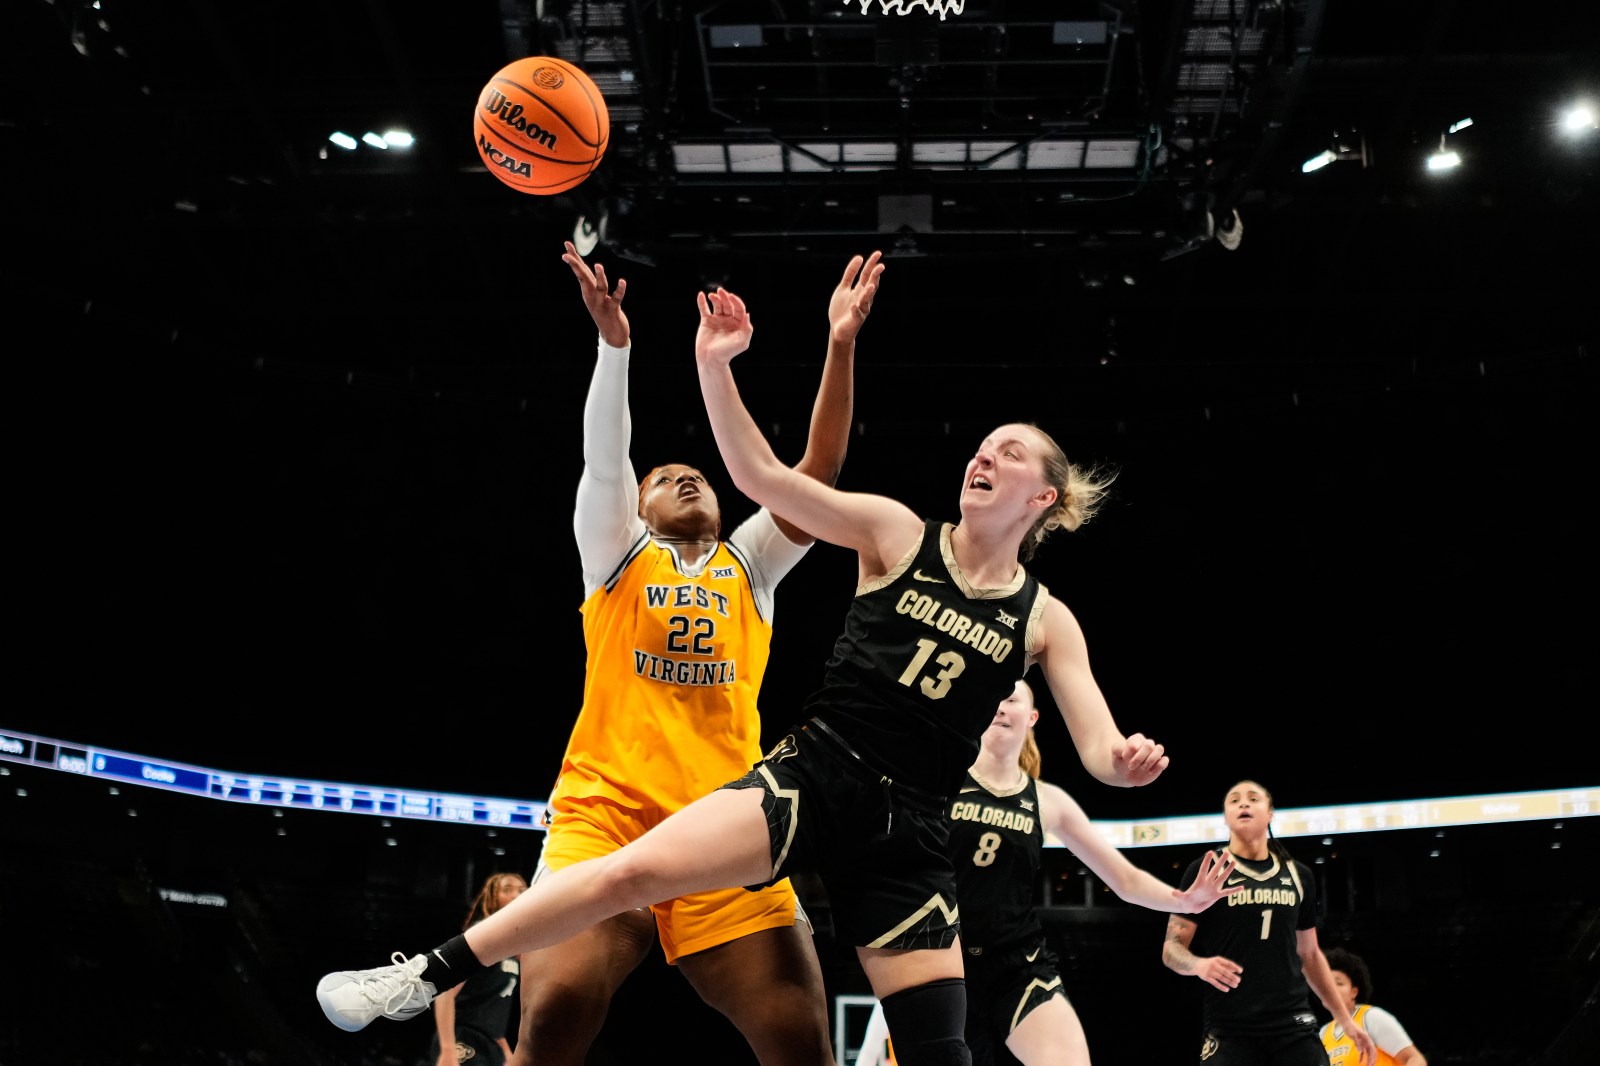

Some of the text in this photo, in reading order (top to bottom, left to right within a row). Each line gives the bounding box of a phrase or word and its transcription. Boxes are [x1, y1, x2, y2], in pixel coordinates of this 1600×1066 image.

[483, 88, 558, 151] Wilson
[477, 133, 533, 178] NCAA
[645, 584, 730, 618] WEST
[667, 615, 715, 656] 22
[895, 589, 1013, 664] COLORADO
[634, 649, 736, 686] VIRGINIA
[898, 638, 966, 701] 13
[950, 802, 1035, 835] COLORADO
[972, 832, 1002, 868] 8
[1228, 888, 1297, 907] COLORADO
[1260, 909, 1273, 940] 1
